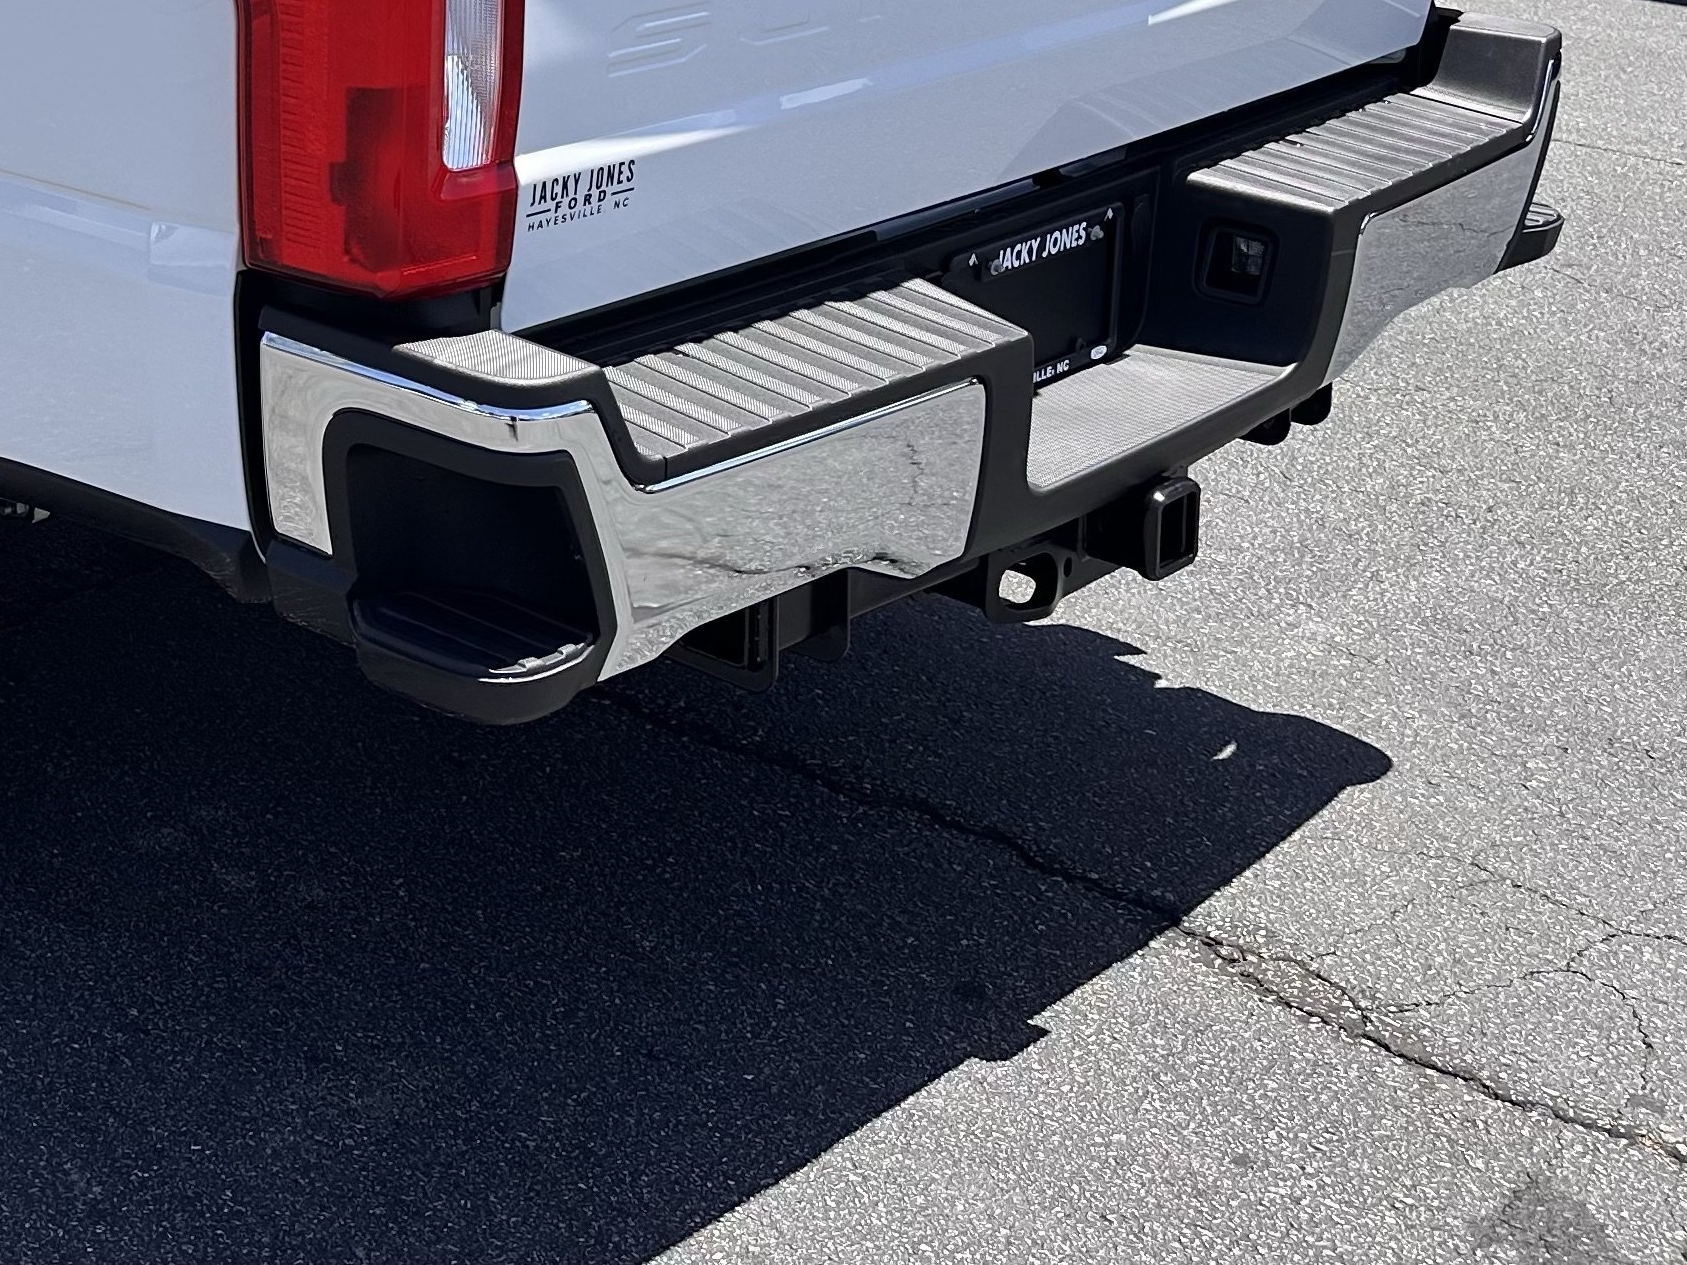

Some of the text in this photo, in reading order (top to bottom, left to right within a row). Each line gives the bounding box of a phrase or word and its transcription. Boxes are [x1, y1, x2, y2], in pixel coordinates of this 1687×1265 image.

[530, 159, 635, 207] JACKY JONES
[554, 189, 607, 214] FORD
[613, 197, 629, 210] NC
[998, 221, 1087, 270] JACKY JONES
[1056, 359, 1070, 374] NC
